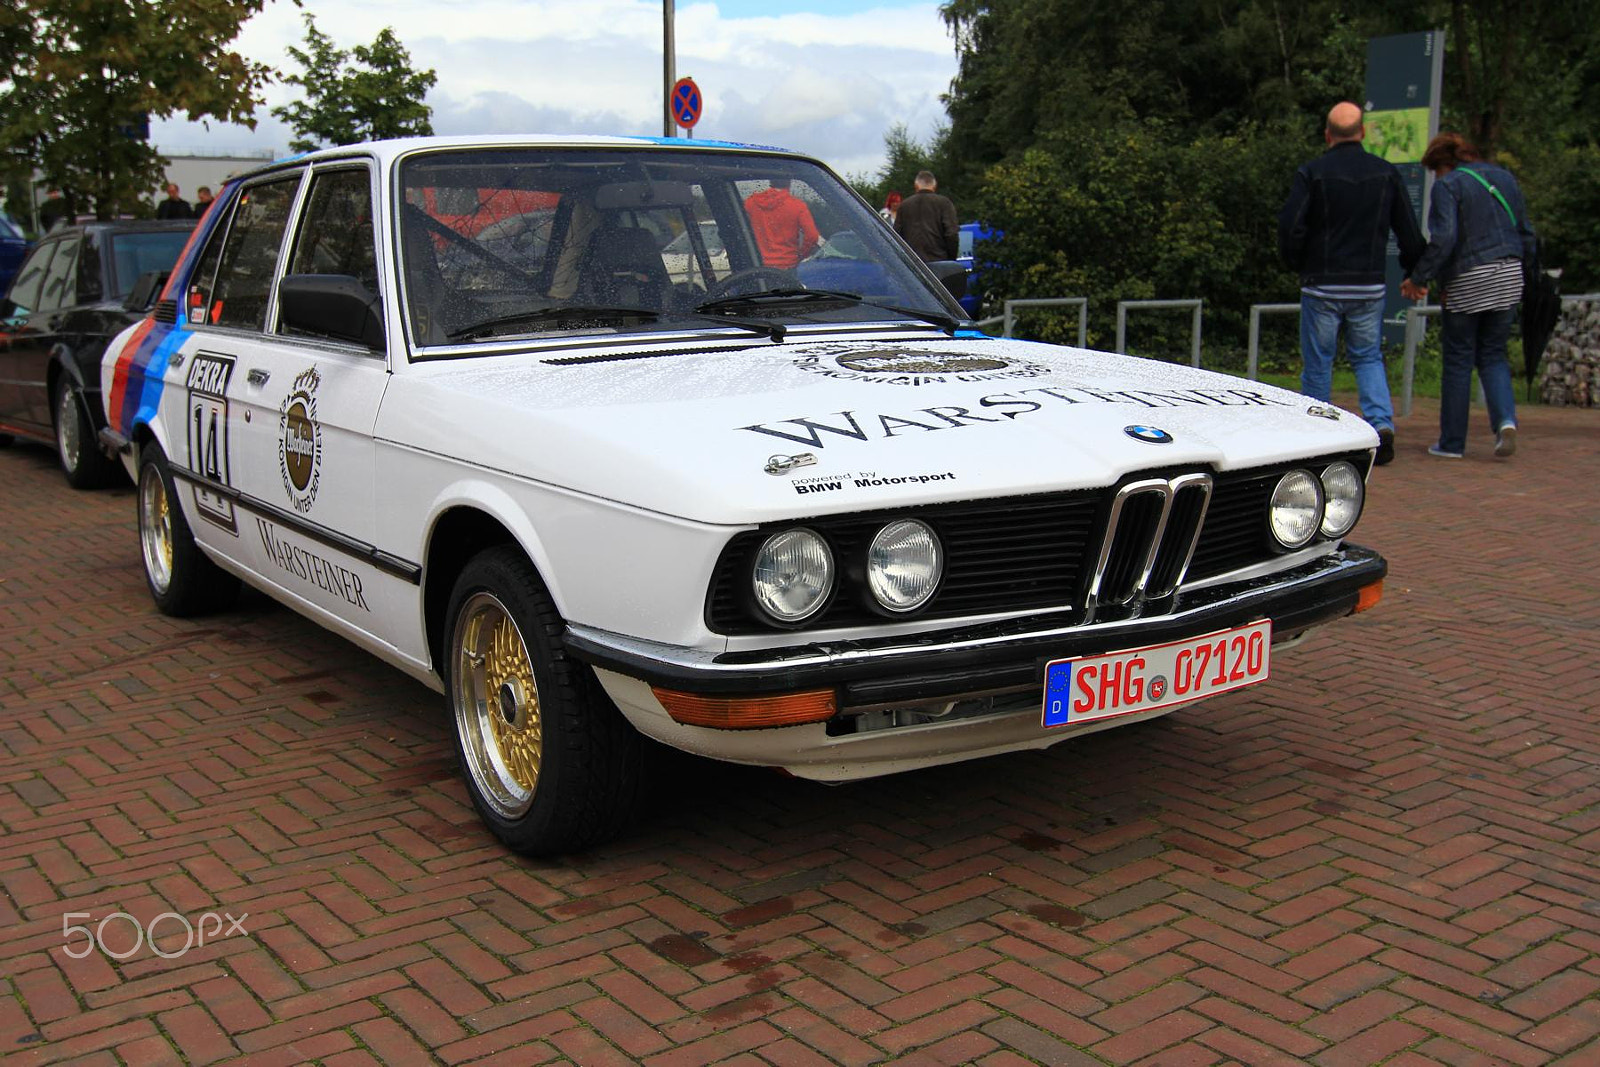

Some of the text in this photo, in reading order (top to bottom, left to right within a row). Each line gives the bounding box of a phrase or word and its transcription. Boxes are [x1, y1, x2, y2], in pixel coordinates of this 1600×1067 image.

[189, 357, 229, 396] DEKRA
[736, 387, 1293, 448] WARSTEINER
[193, 403, 223, 509] 14
[791, 471, 877, 486] powered by
[795, 472, 957, 495] BMW Motorsport
[256, 517, 370, 612] WARSTEINER
[1073, 631, 1264, 714] SHG 07120
[1052, 700, 1062, 714] D
